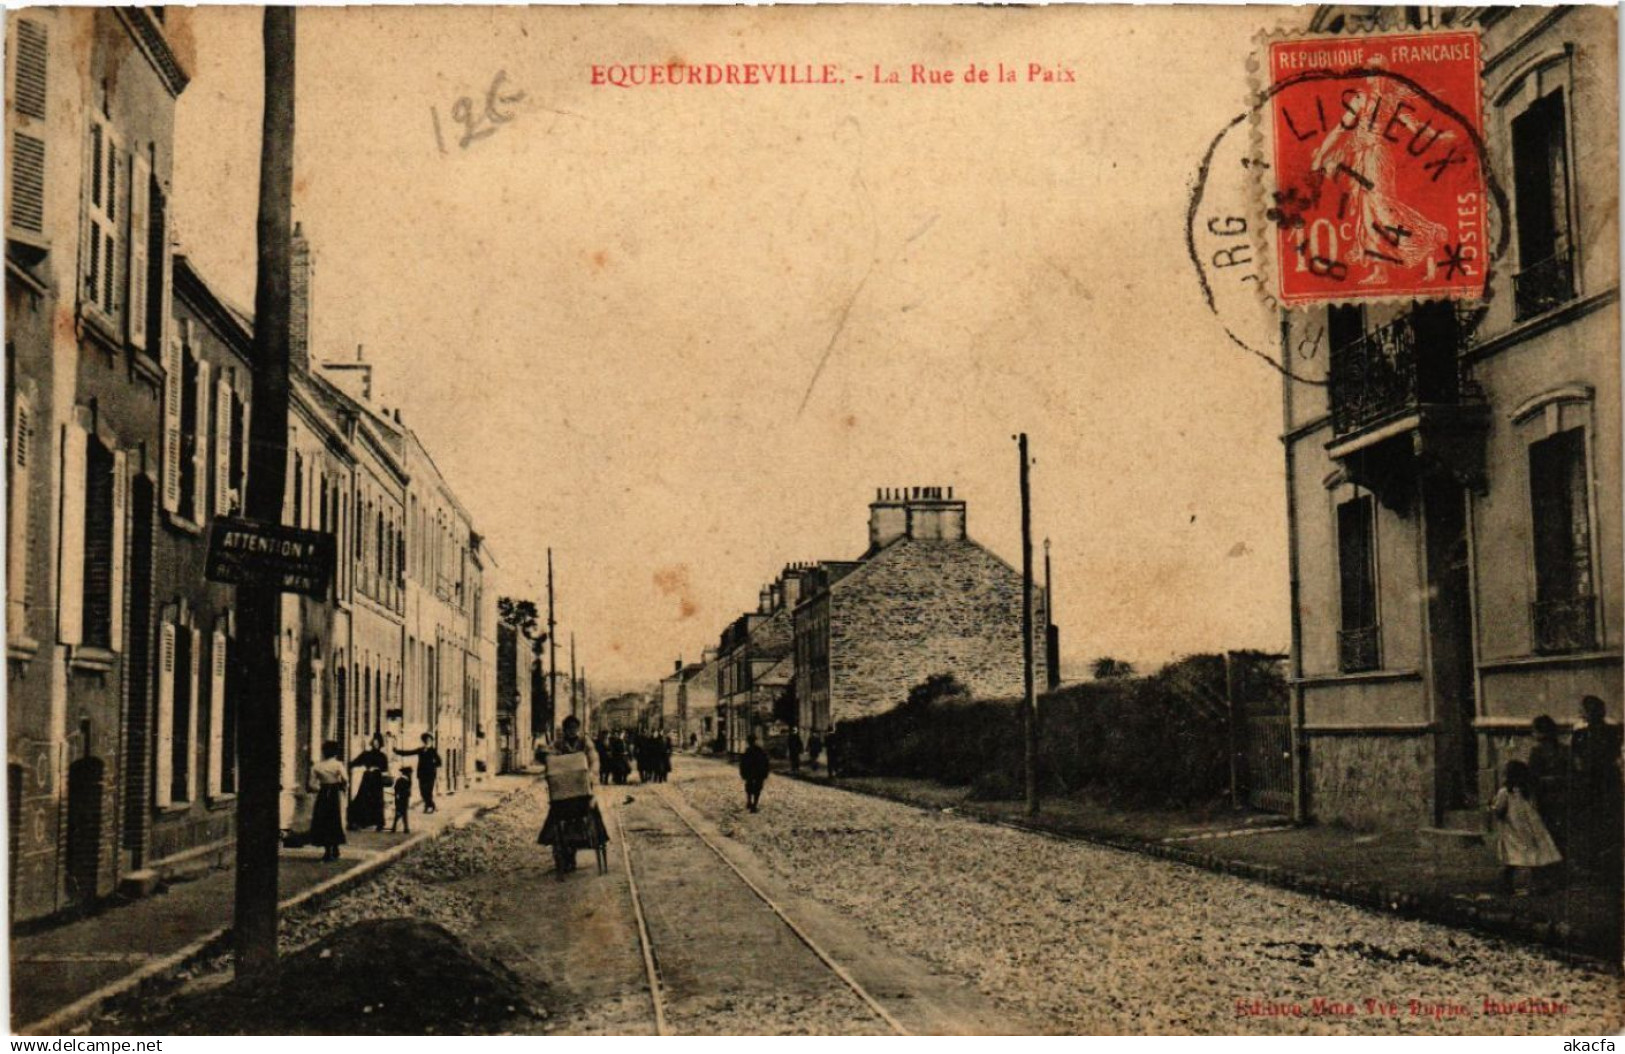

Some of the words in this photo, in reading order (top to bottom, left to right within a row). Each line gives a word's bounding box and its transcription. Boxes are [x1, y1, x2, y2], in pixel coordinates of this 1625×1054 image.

[1391, 42, 1471, 64] FRANÇAISE
[1282, 88, 1468, 182] LISIEUX
[1457, 191, 1479, 276] POSTES
[223, 531, 302, 558] ATTENTION
